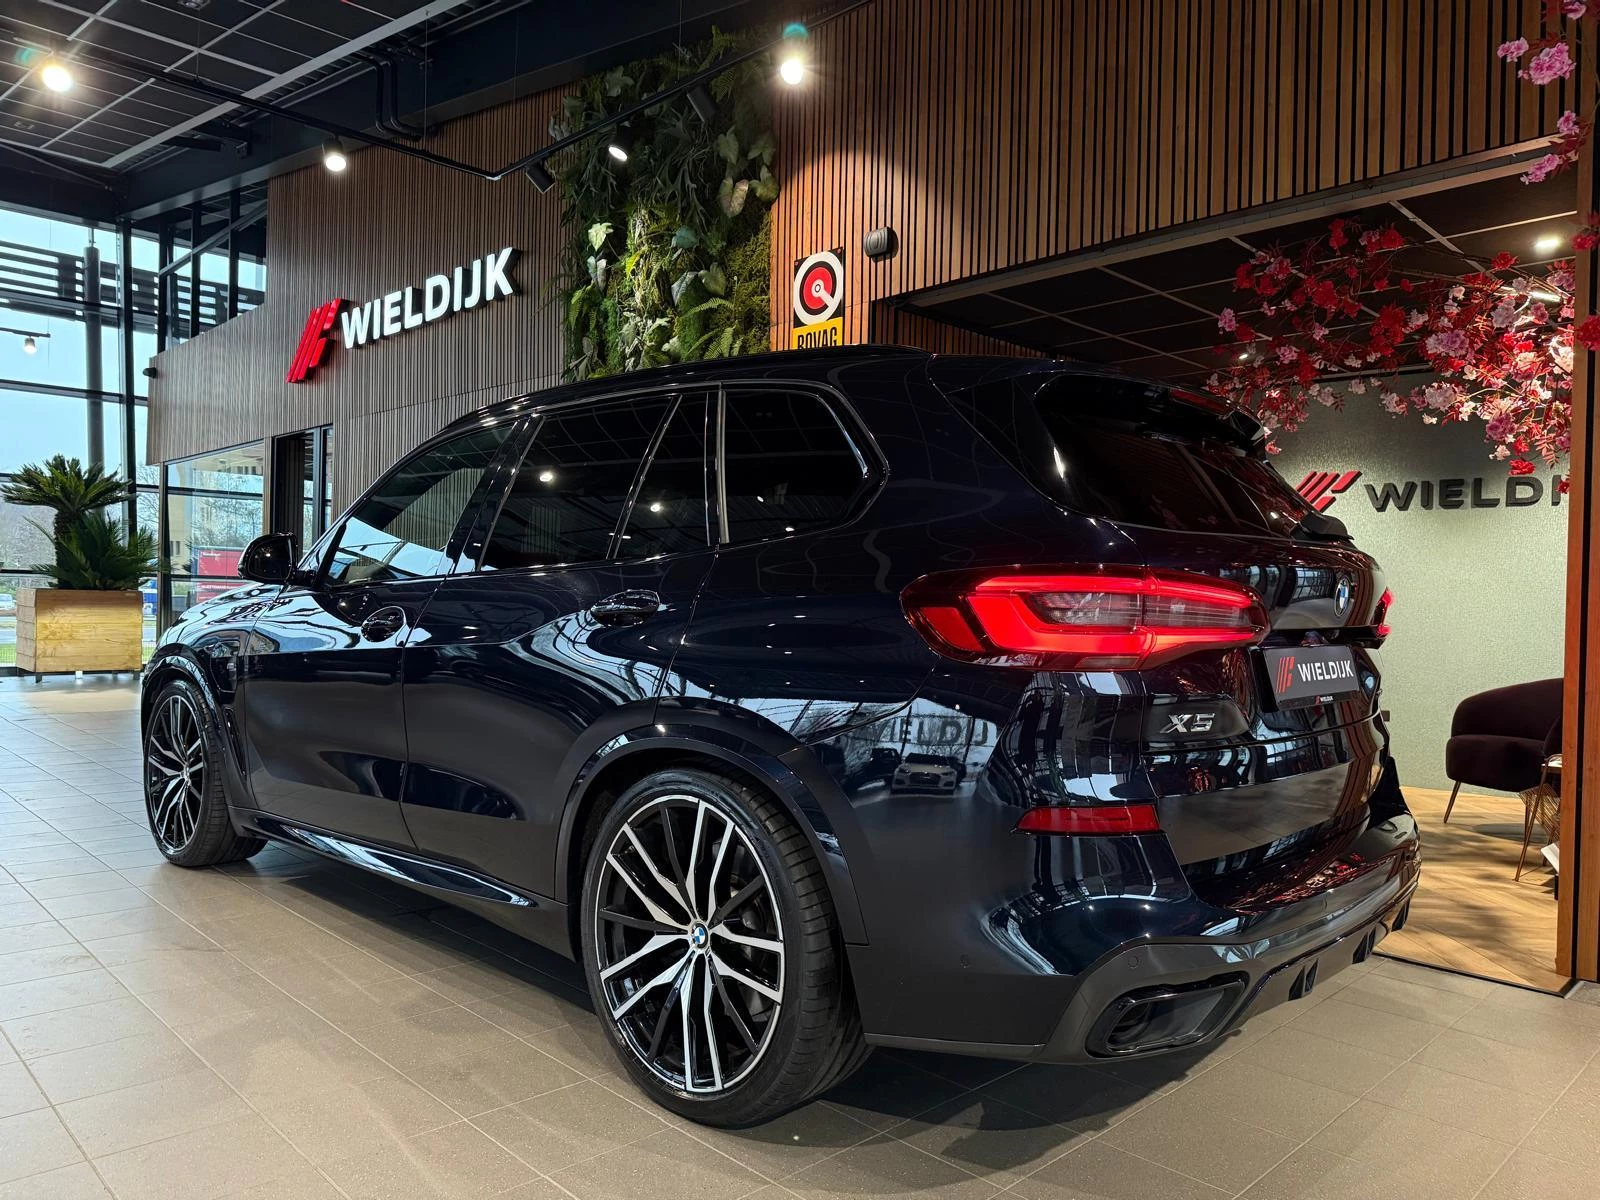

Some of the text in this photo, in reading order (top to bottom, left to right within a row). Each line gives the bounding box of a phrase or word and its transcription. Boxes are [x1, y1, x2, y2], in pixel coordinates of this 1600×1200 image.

[341, 246, 515, 349] WIELDIJK
[797, 326, 838, 350] BOVAG
[1298, 660, 1354, 682] WIELDIJK
[1160, 713, 1216, 733] X5
